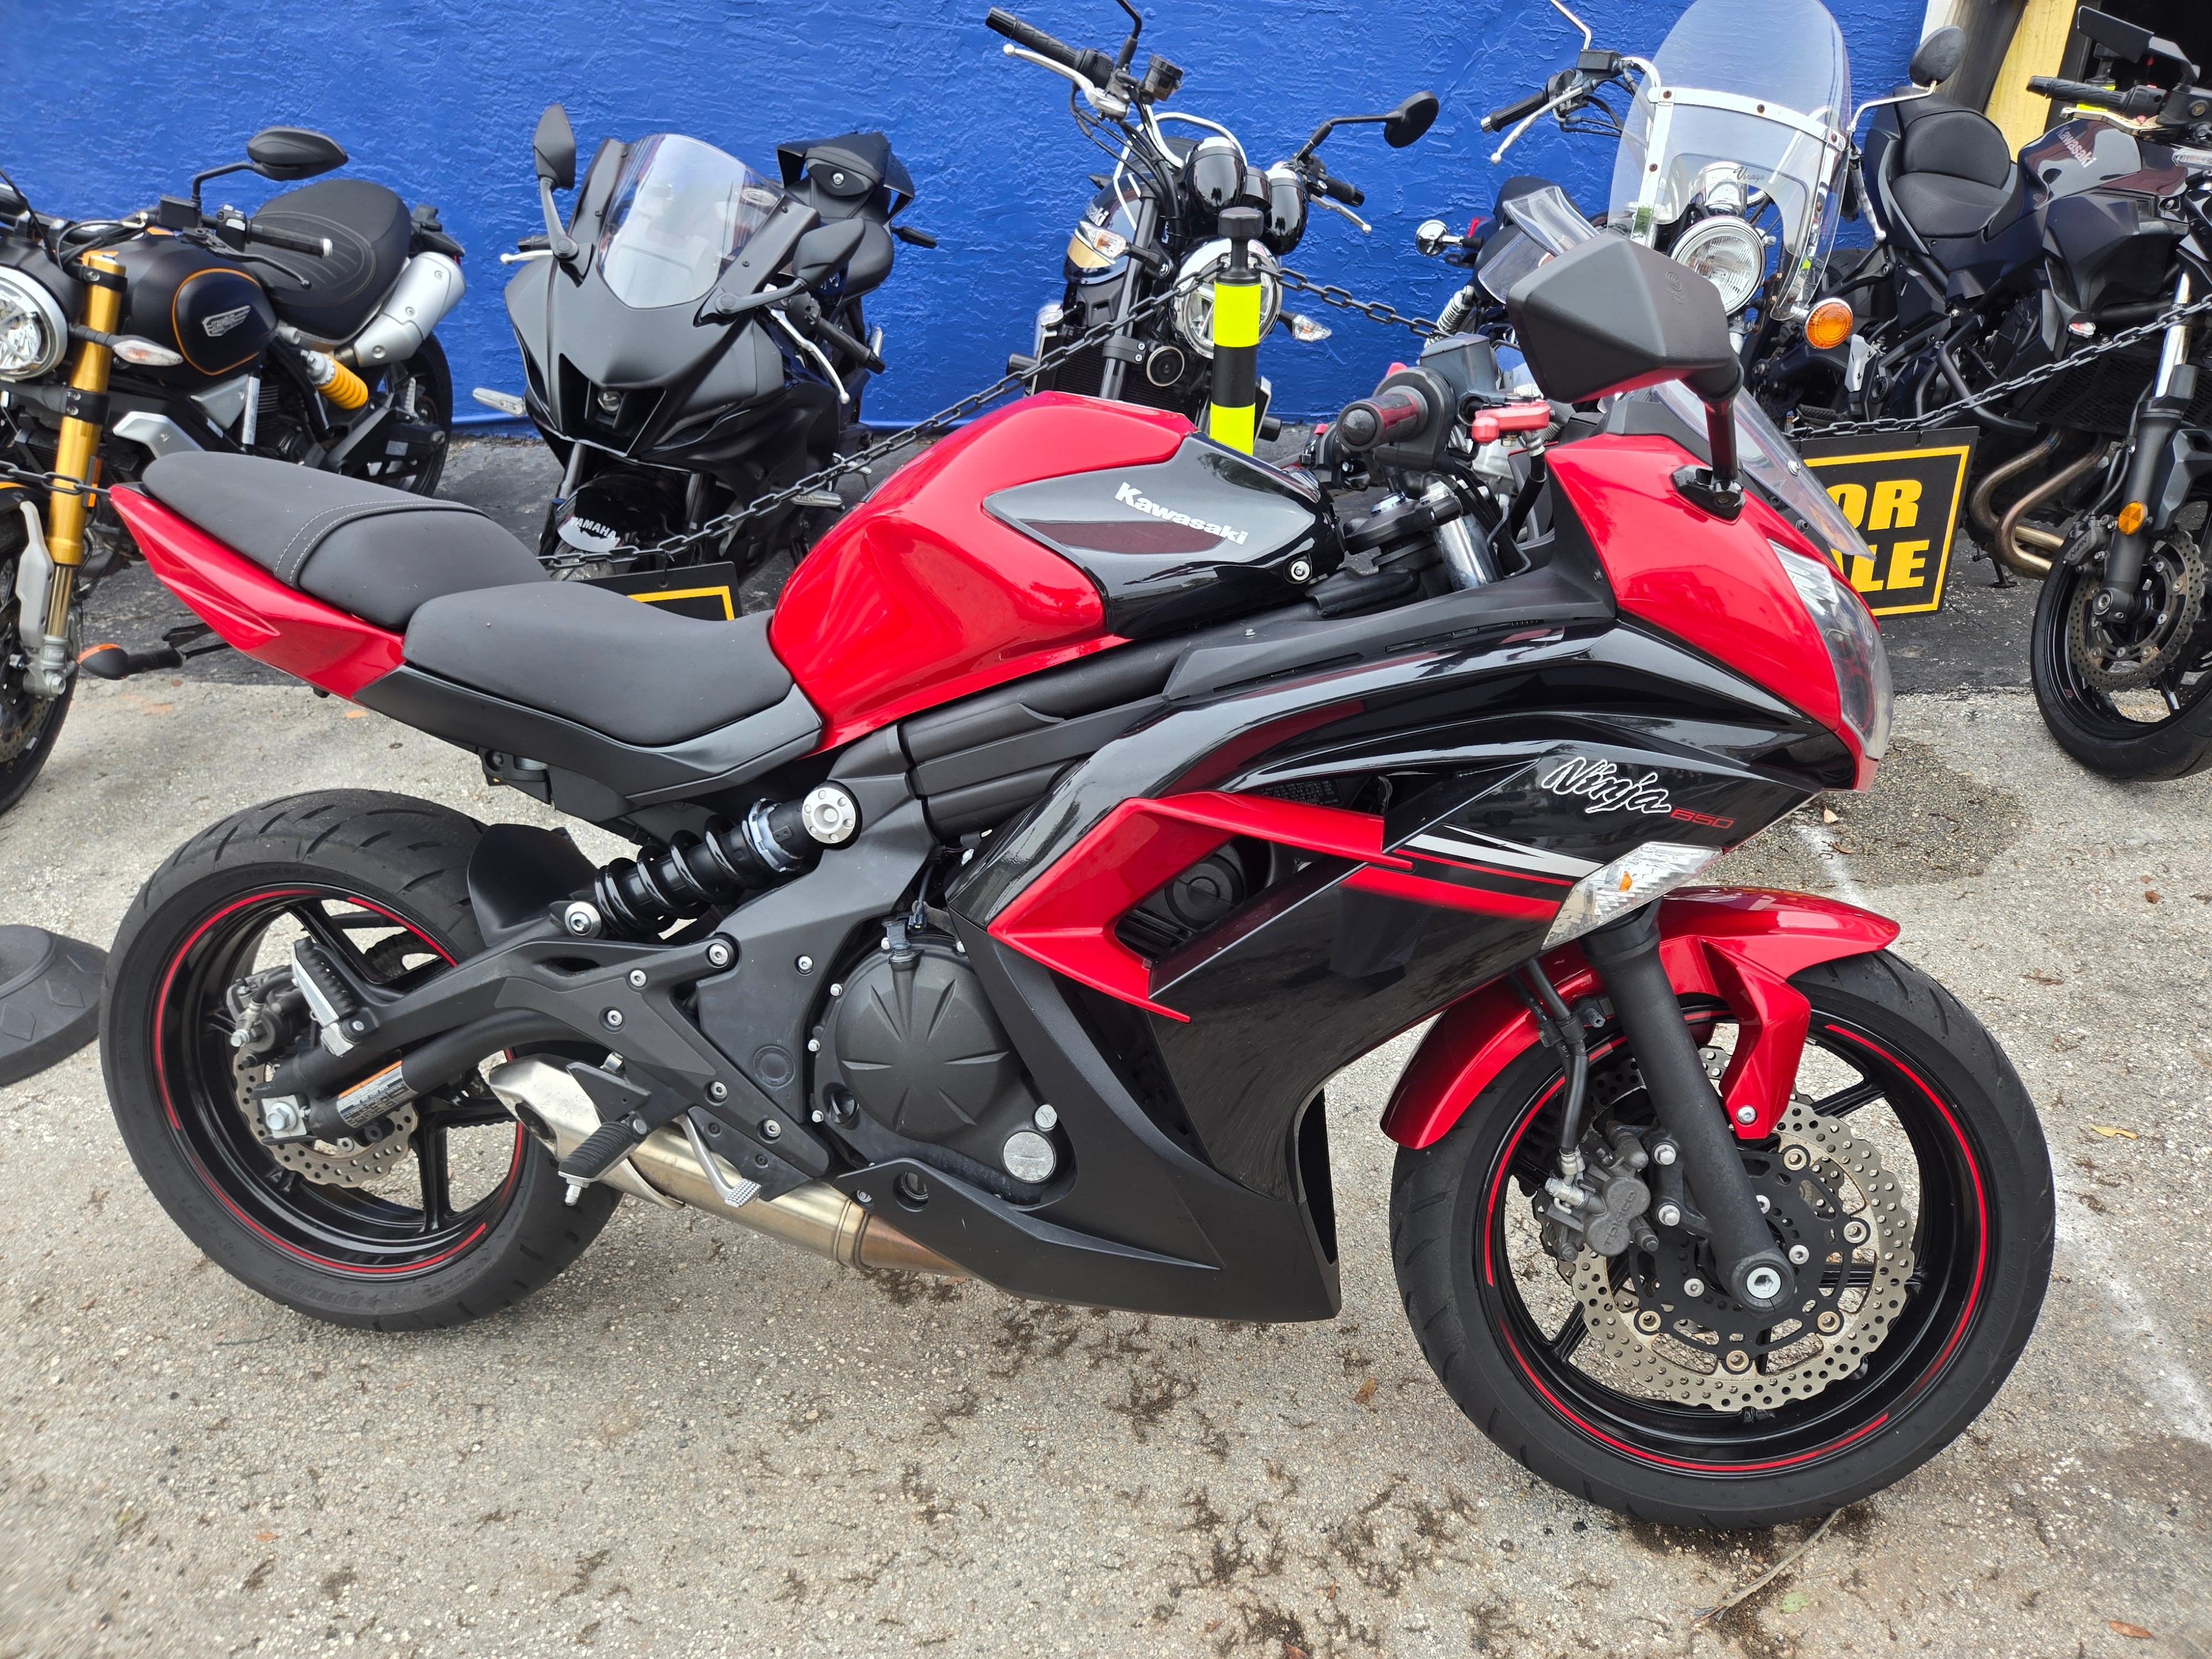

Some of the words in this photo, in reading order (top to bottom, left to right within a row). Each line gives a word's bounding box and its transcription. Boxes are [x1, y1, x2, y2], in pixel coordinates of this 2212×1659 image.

[2056, 125, 2097, 168] Kawasaki
[1733, 166, 1765, 184] Virago
[570, 517, 617, 540] YAMAHA
[1115, 482, 1249, 546] Kawasaki
[1825, 480, 1922, 530] OR
[1830, 540, 1929, 592] LE
[1541, 757, 1672, 813] Ninja
[1670, 807, 1735, 828] 650
[1603, 1190, 1636, 1246] TOKICO
